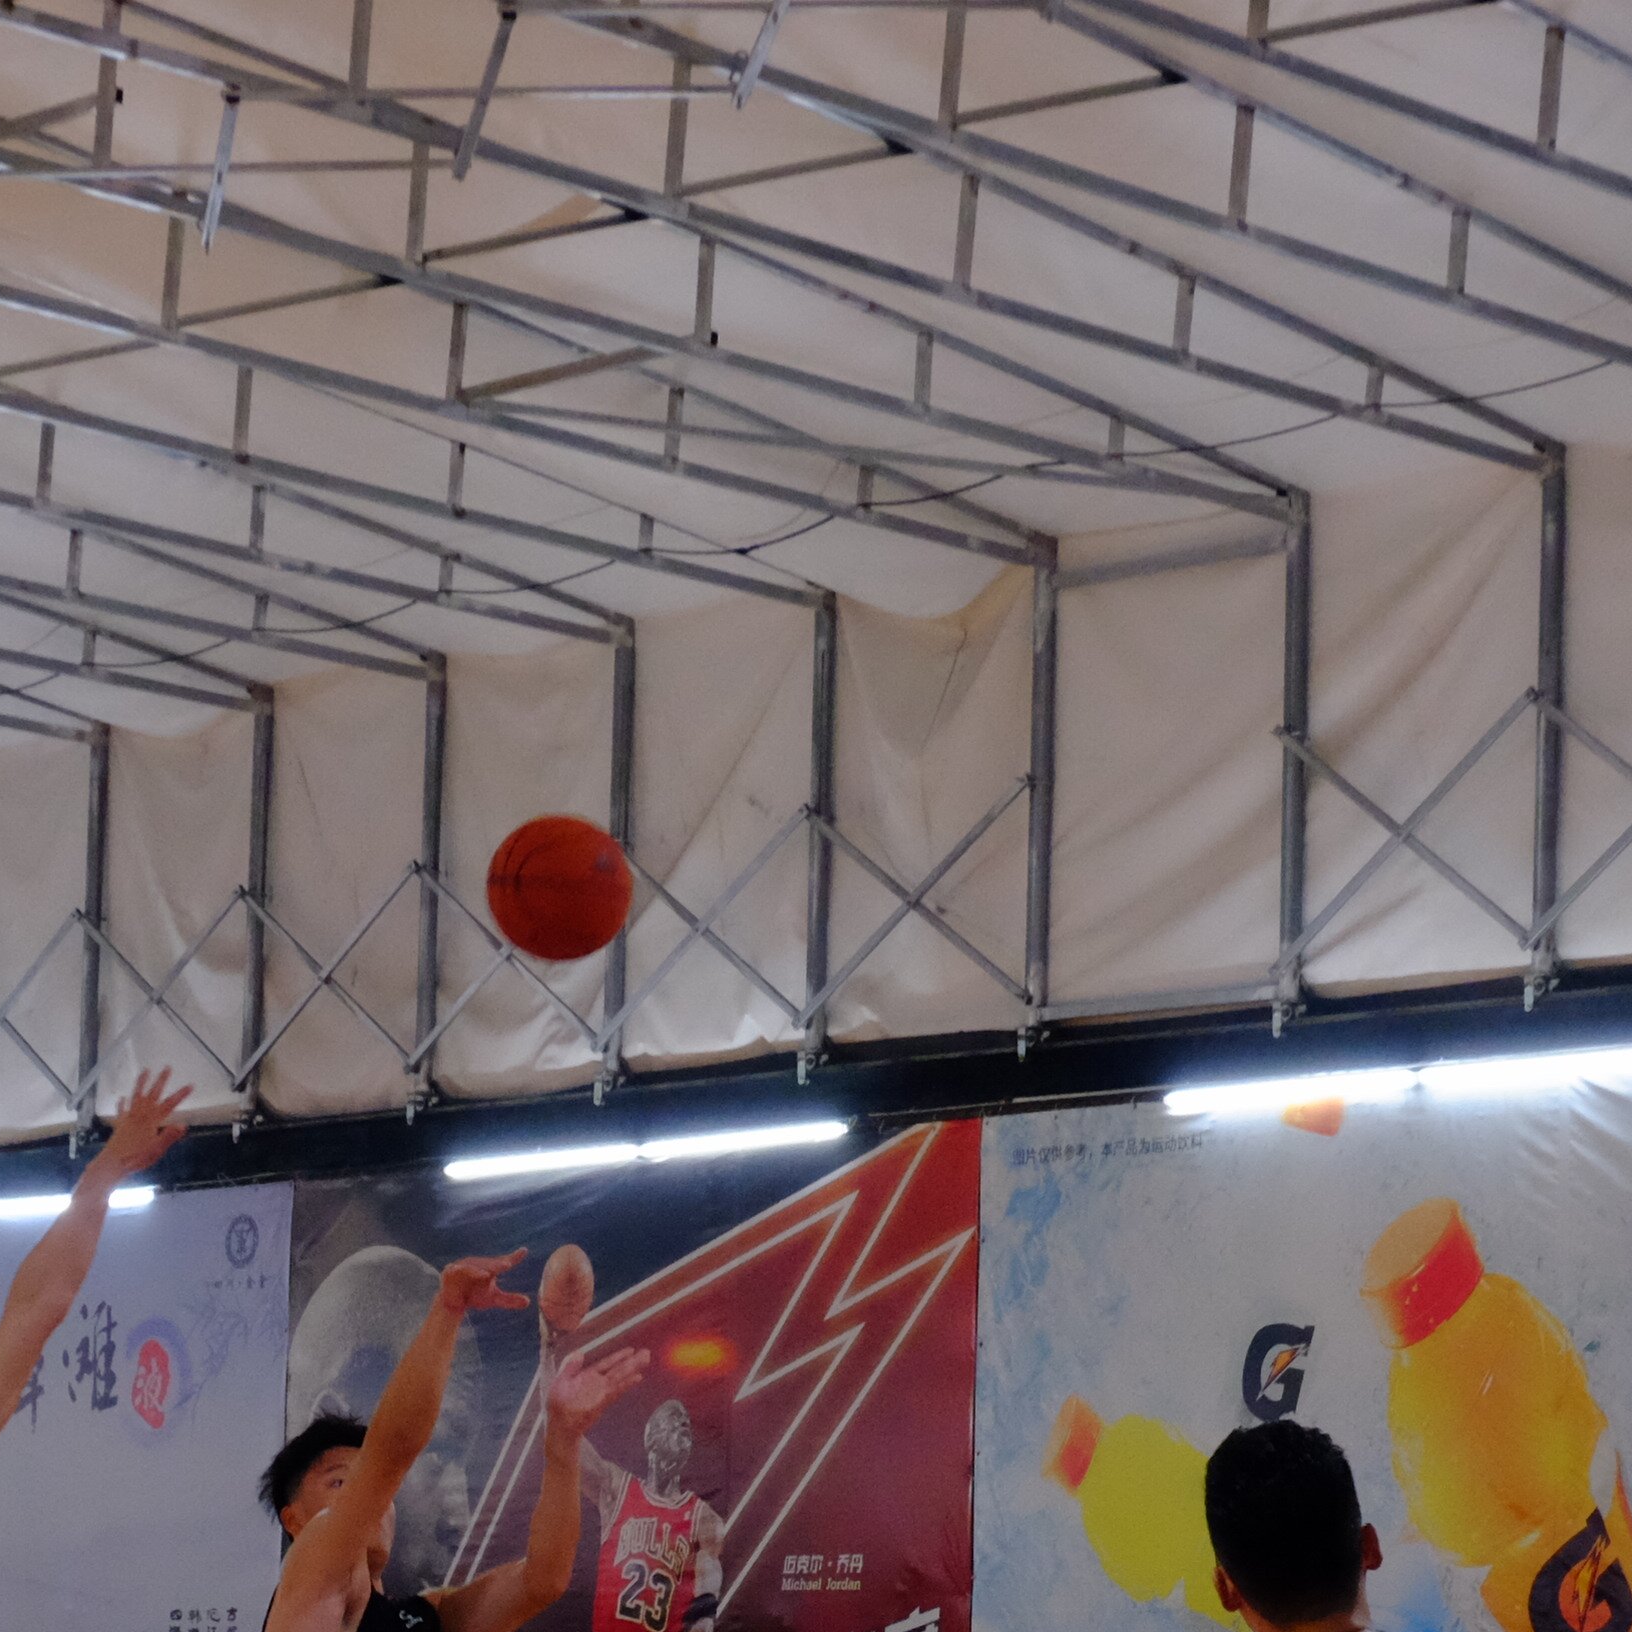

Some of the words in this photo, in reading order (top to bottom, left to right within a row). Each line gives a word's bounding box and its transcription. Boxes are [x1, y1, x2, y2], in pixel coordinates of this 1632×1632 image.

[1242, 1323, 1314, 1419] G
[613, 1516, 689, 1585] BULLS
[783, 1553, 863, 1574] 迈克尔·乔丹
[781, 1576, 822, 1592] Michael
[825, 1575, 862, 1591] Jordan
